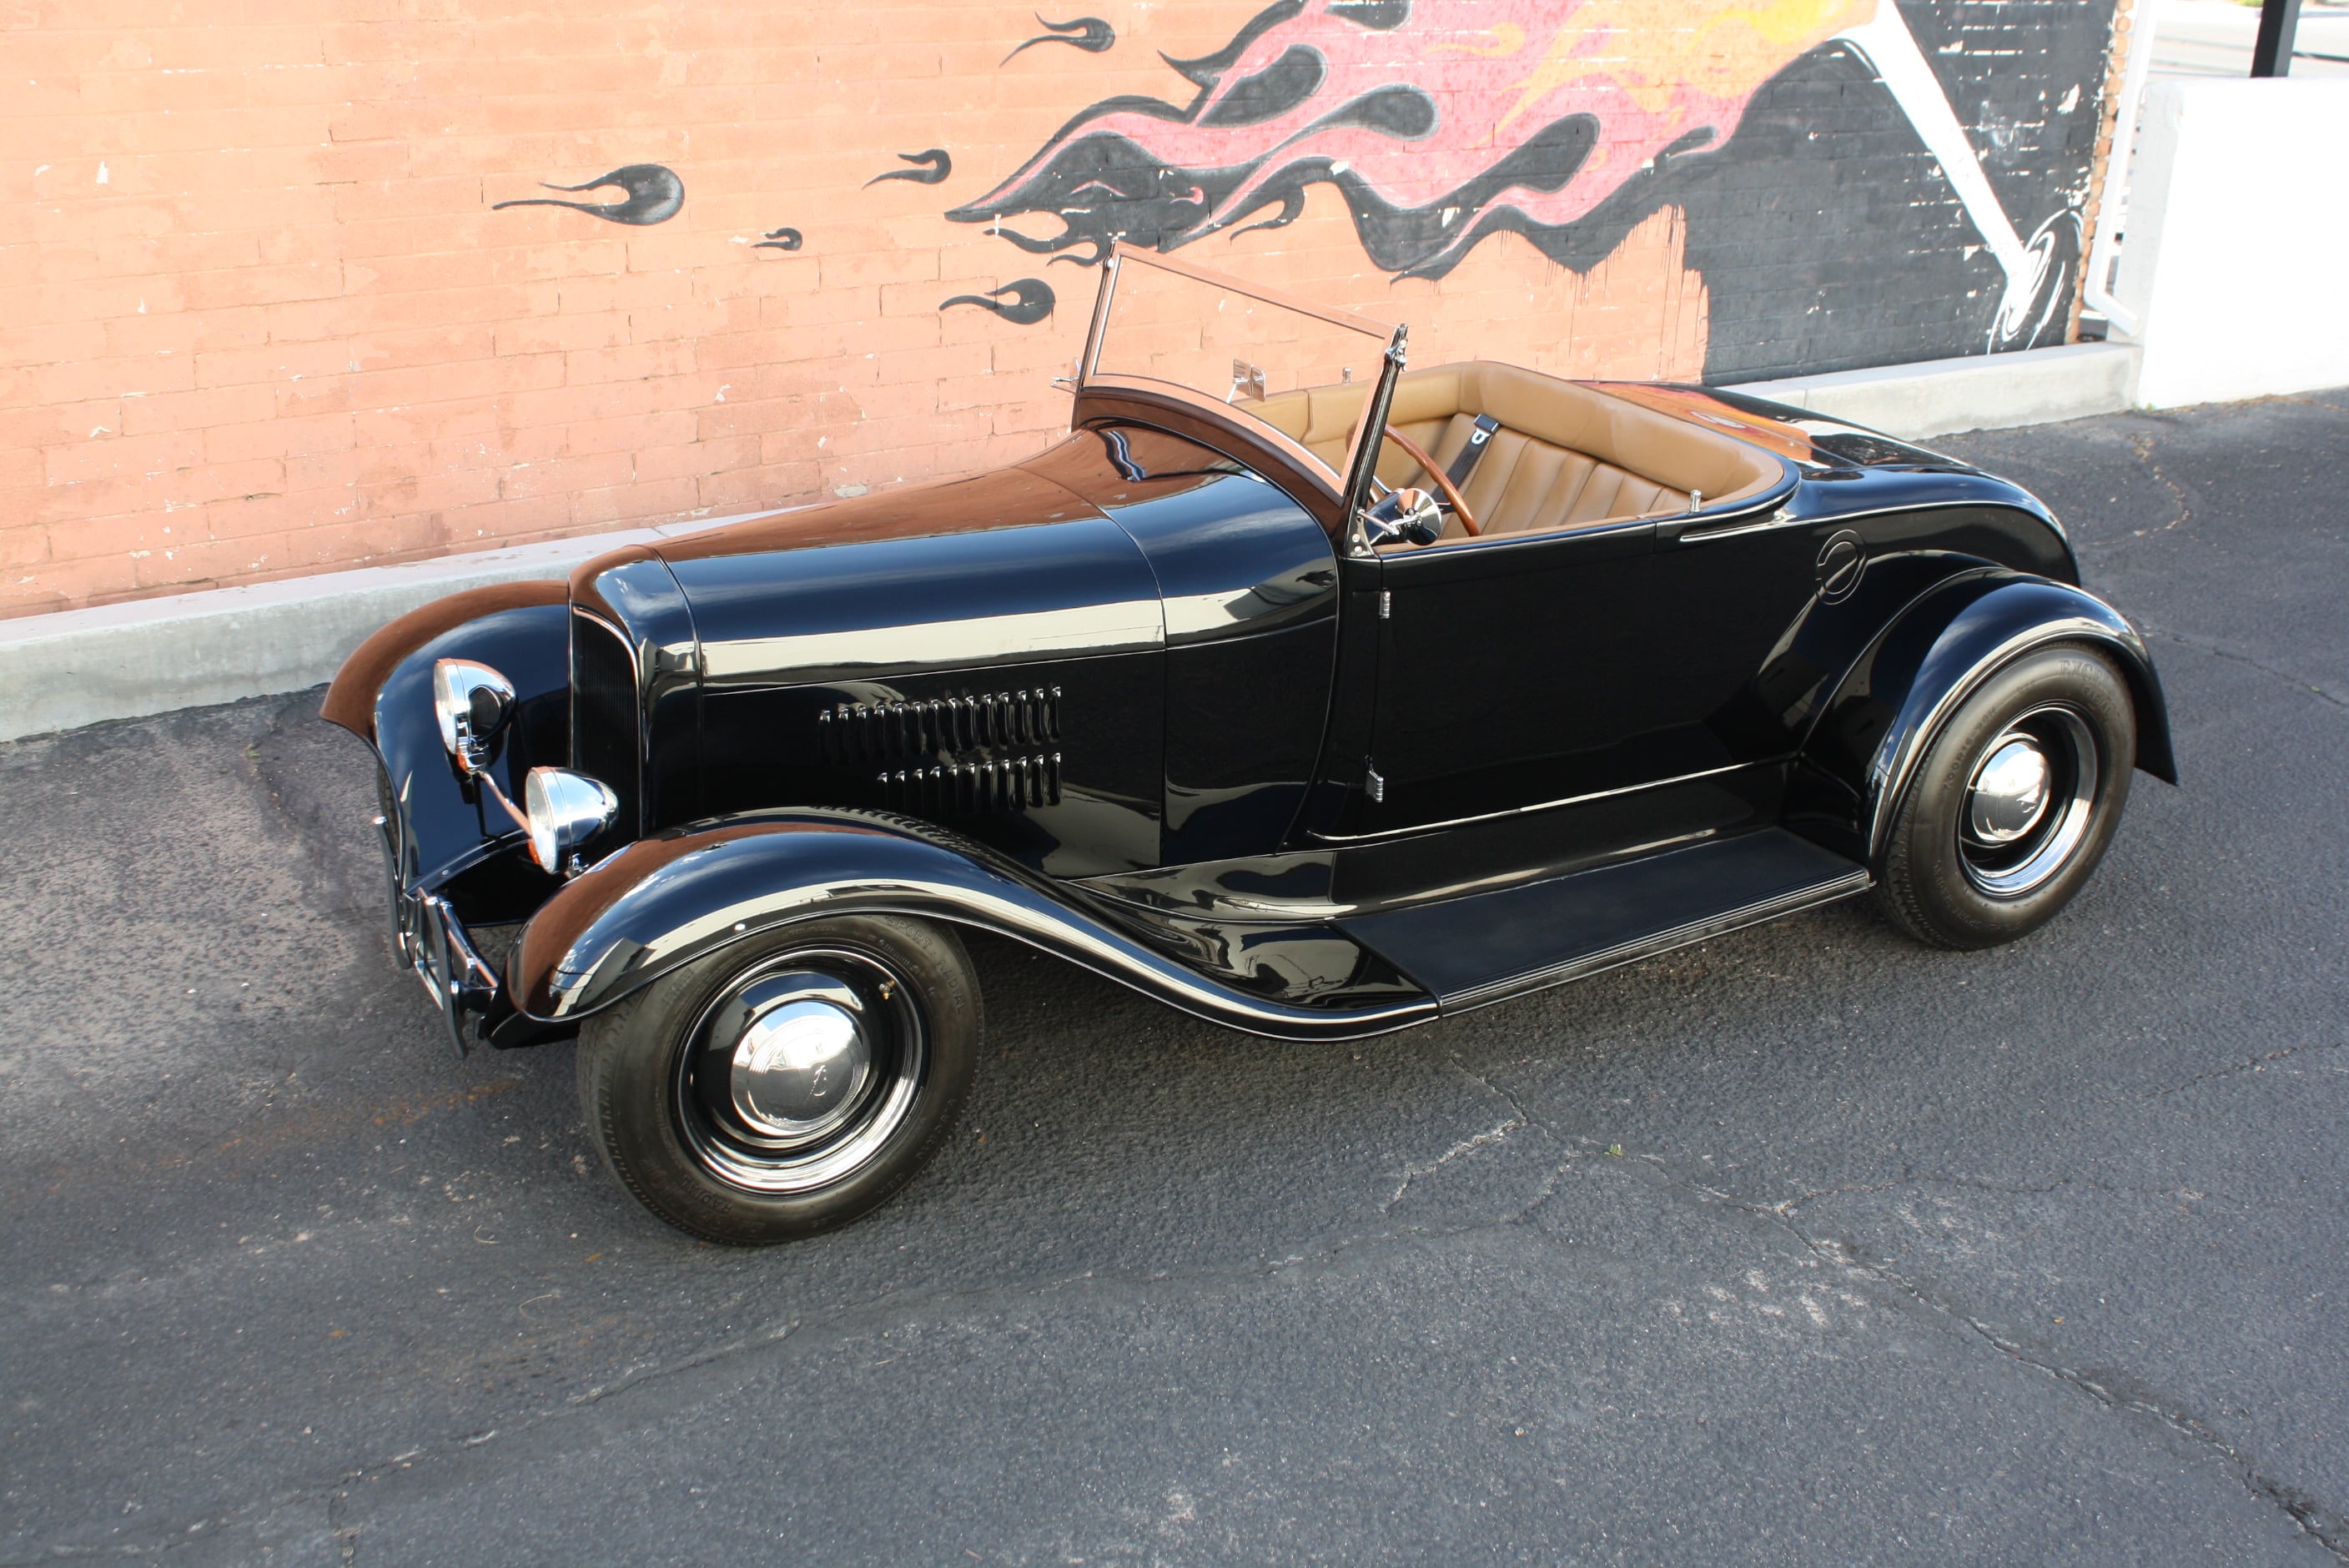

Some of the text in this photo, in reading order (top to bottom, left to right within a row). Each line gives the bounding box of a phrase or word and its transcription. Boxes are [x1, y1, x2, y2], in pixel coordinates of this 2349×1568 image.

[887, 915, 933, 950] SPORT
[937, 959, 966, 1015] RADIAL
[680, 1173, 734, 1214] RADIAL
